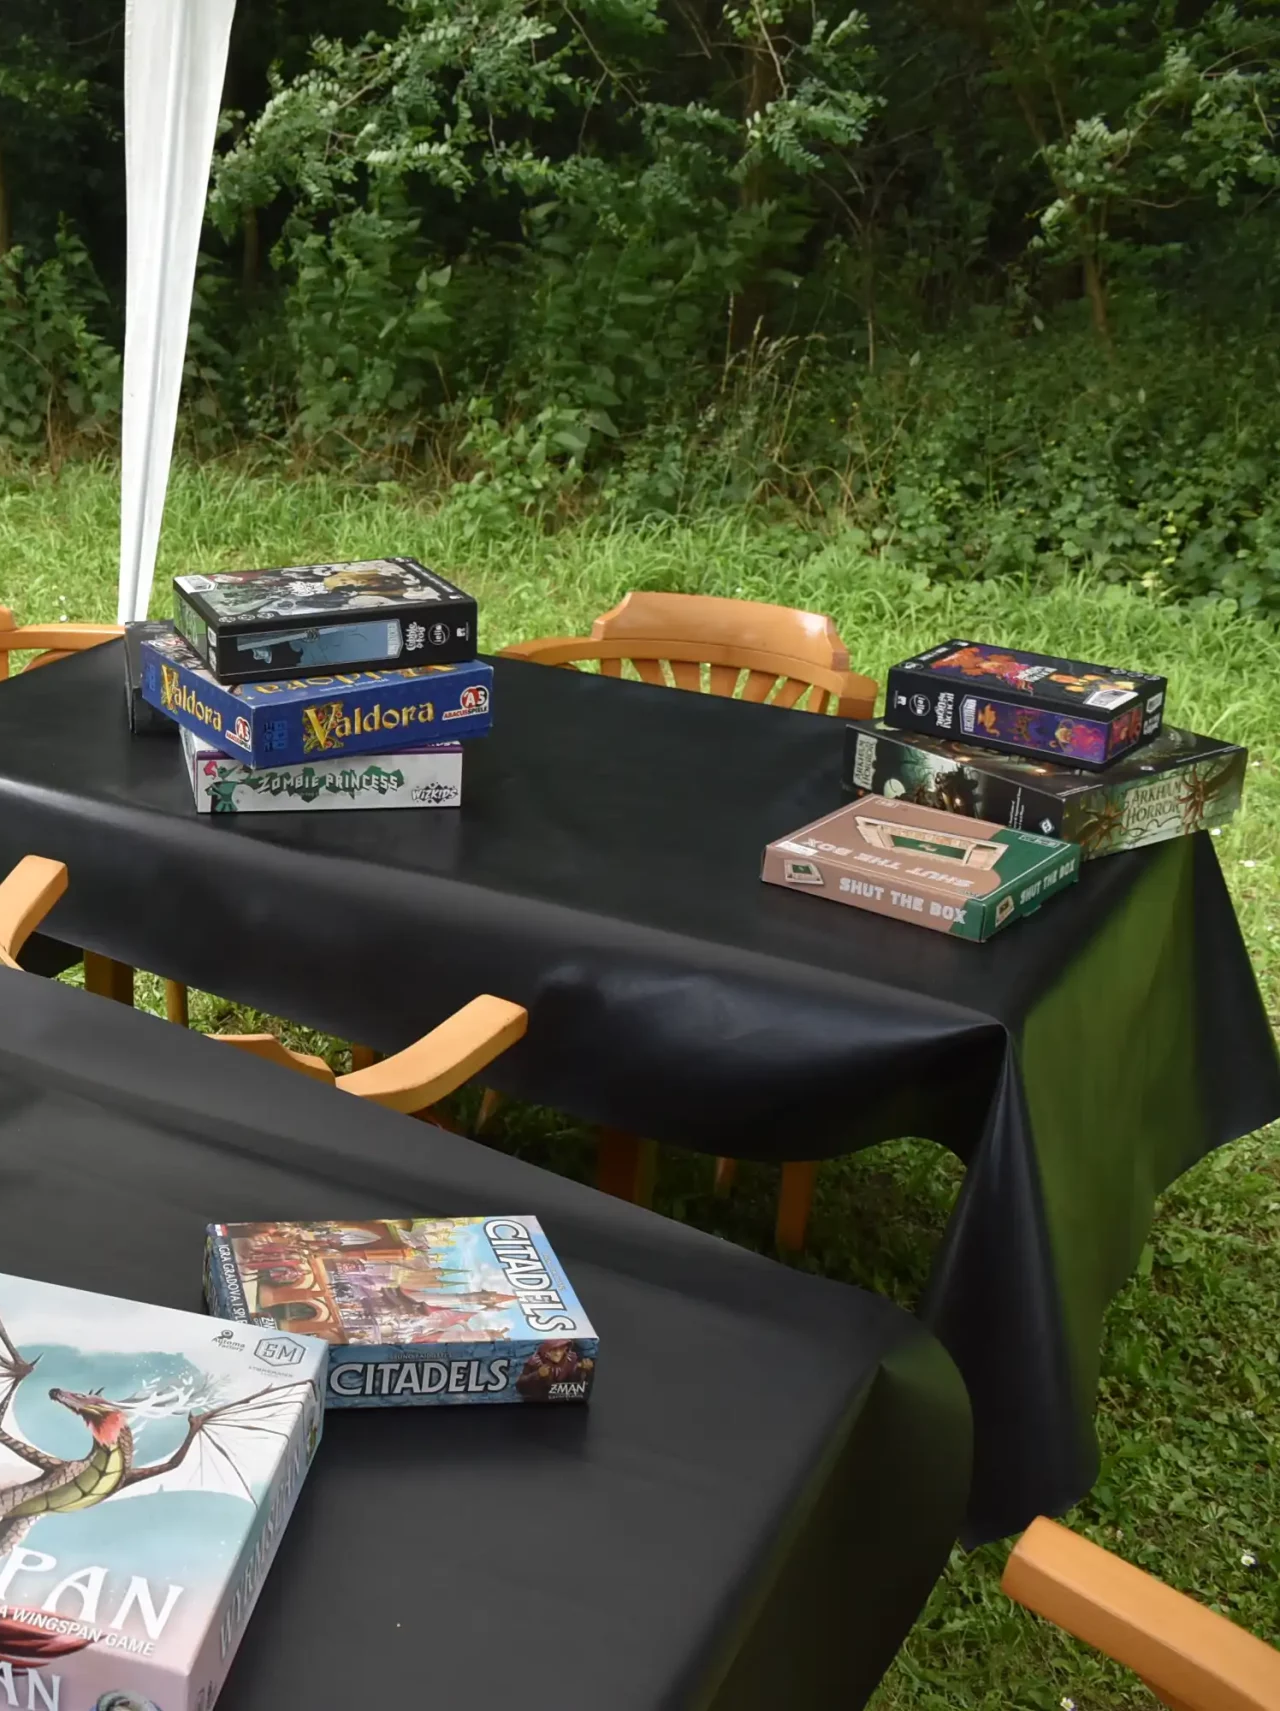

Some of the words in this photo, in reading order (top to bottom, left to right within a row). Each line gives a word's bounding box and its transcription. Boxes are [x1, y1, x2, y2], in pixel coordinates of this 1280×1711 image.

[162, 664, 223, 732] Valdora
[304, 701, 435, 749] Valdora
[257, 775, 319, 791] ZOMBIE
[325, 772, 399, 792] PRINCESS
[838, 877, 885, 901] SHUT
[891, 890, 924, 912] THE
[929, 901, 968, 925] BOX
[1020, 880, 1041, 905] SHUT
[218, 1244, 232, 1262] IGRA
[222, 1262, 242, 1302] GRADOVA
[483, 1219, 577, 1333] CITADELS
[211, 1336, 246, 1349] Automa
[329, 1358, 510, 1396] CITADELS
[12, 1607, 103, 1643] WINGSPAN
[105, 1632, 157, 1658] GAME
